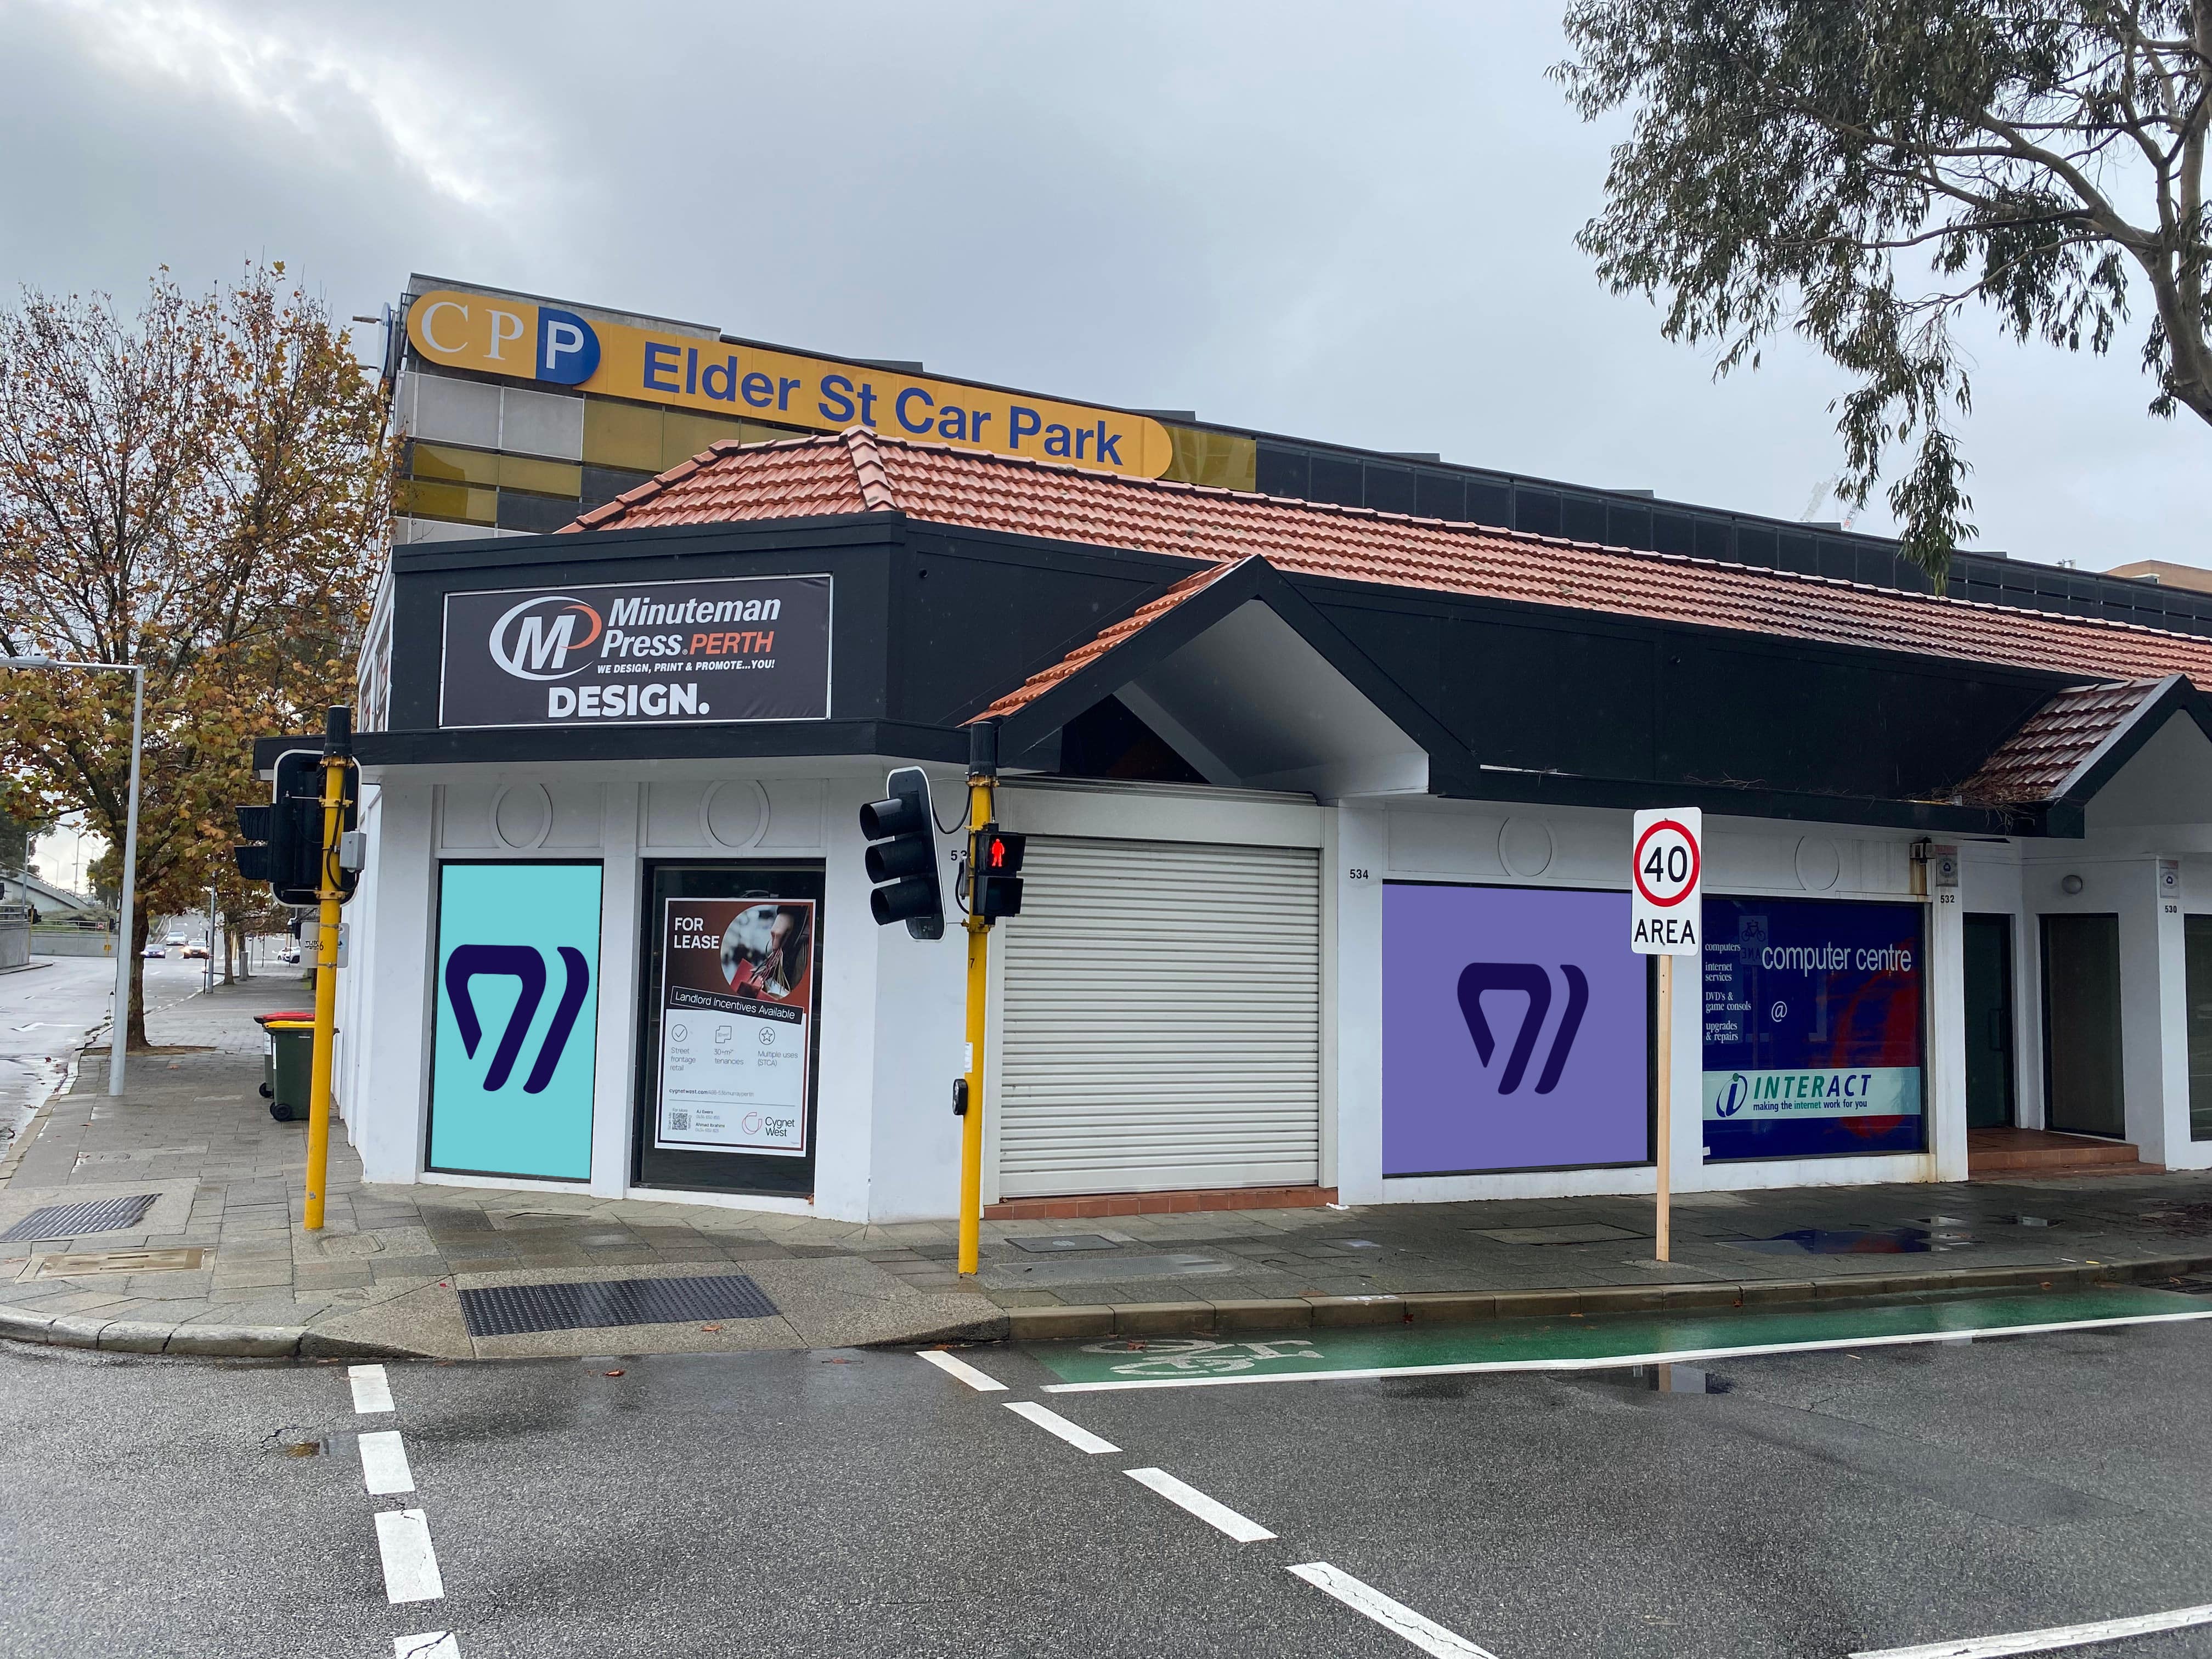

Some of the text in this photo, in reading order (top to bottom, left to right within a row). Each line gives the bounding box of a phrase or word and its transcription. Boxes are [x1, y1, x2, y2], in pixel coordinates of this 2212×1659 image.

[643, 341, 1124, 466] Elder St Car Park
[607, 596, 781, 627] Minuteman
[689, 630, 775, 656] PERTH
[597, 664, 611, 674] WE
[613, 663, 652, 675] DESIGN,
[654, 662, 684, 673] PRINT
[685, 662, 693, 671] &
[548, 683, 710, 718] DESIGN.
[950, 850, 967, 861] 53
[1644, 845, 1688, 883] 40
[1350, 868, 1369, 879] 534
[1940, 894, 1955, 904] 532
[2164, 905, 2177, 913] 530
[674, 917, 704, 932] FOR
[1634, 918, 1696, 945] AREA
[673, 934, 720, 950] LEASE
[1705, 943, 1741, 954] computers
[969, 957, 975, 969] 7
[1762, 941, 1912, 977] computer centre
[1705, 961, 1733, 971] internet
[1705, 972, 1733, 981] services
[1728, 991, 1734, 1001] &
[675, 991, 795, 1020] Landlord Incentives Available
[1705, 1001, 1752, 1014] game consols
[1771, 1001, 1788, 1023] @
[1705, 1020, 1738, 1033] upgrades
[1705, 1031, 1739, 1044] & repairs
[670, 1056, 696, 1065] frontage
[714, 1057, 744, 1065] tenancies
[757, 1050, 782, 1059] Multiple
[757, 1058, 777, 1067] (STCA)
[1753, 1074, 1872, 1099] INTERACT
[1753, 1099, 1868, 1113] making the internet work for you
[765, 1116, 795, 1130] Cygnet
[765, 1127, 787, 1137] West
